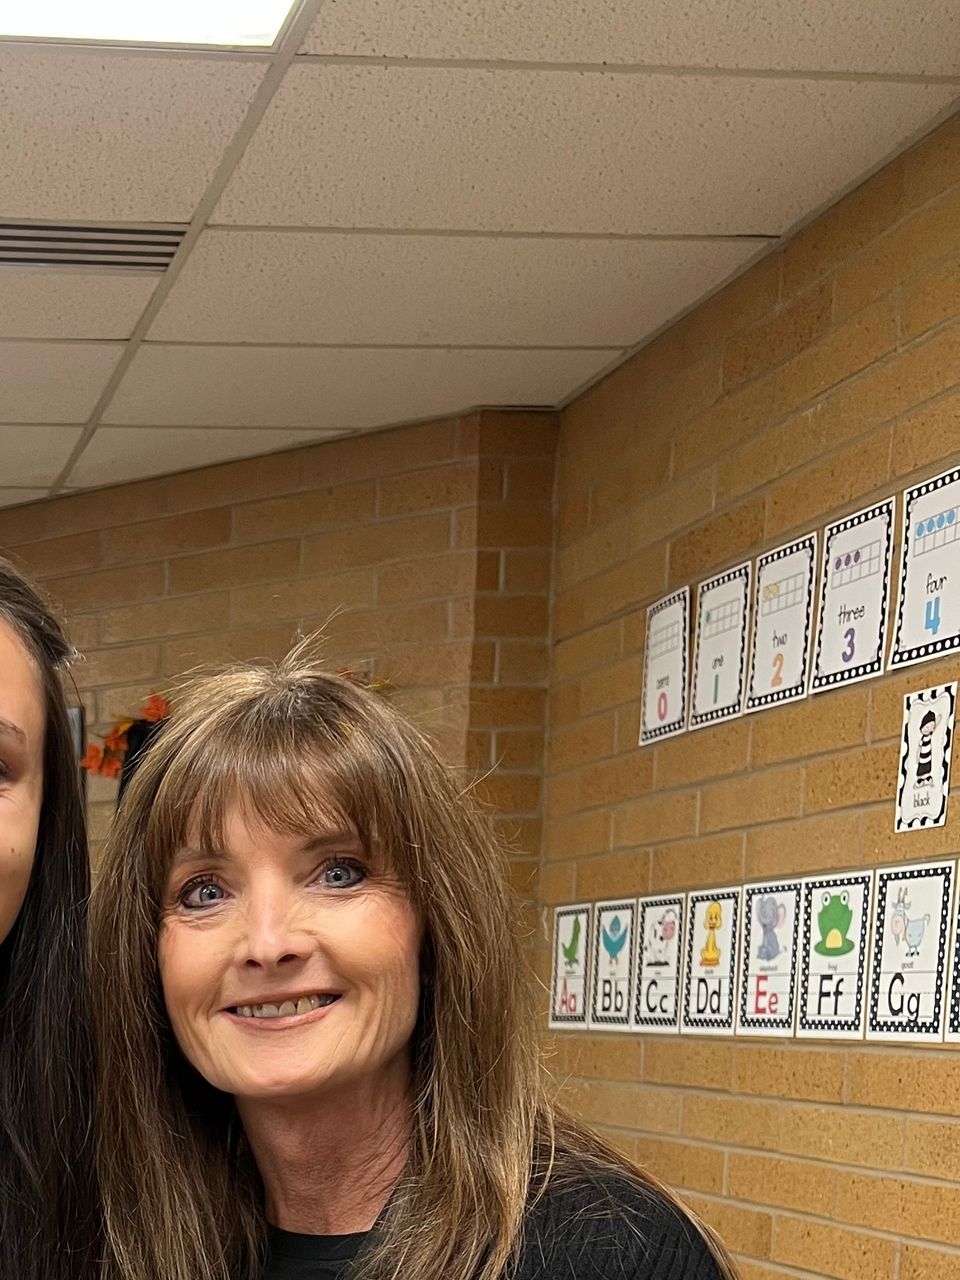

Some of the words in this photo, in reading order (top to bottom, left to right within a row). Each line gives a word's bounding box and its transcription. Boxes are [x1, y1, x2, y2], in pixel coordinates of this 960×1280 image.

[926, 572, 948, 595] four
[837, 604, 865, 626] three
[924, 596, 940, 636] 4
[772, 630, 788, 649] two
[841, 627, 855, 663] 3
[770, 652, 784, 687] 2
[657, 692, 667, 722] 0
[560, 978, 577, 1014] Aa
[602, 979, 623, 1012] Bb
[646, 978, 668, 1013] Cc
[696, 978, 721, 1014] Dd
[754, 975, 779, 1015] Ee
[817, 974, 844, 1016] Ff
[888, 972, 921, 1022] Gg
